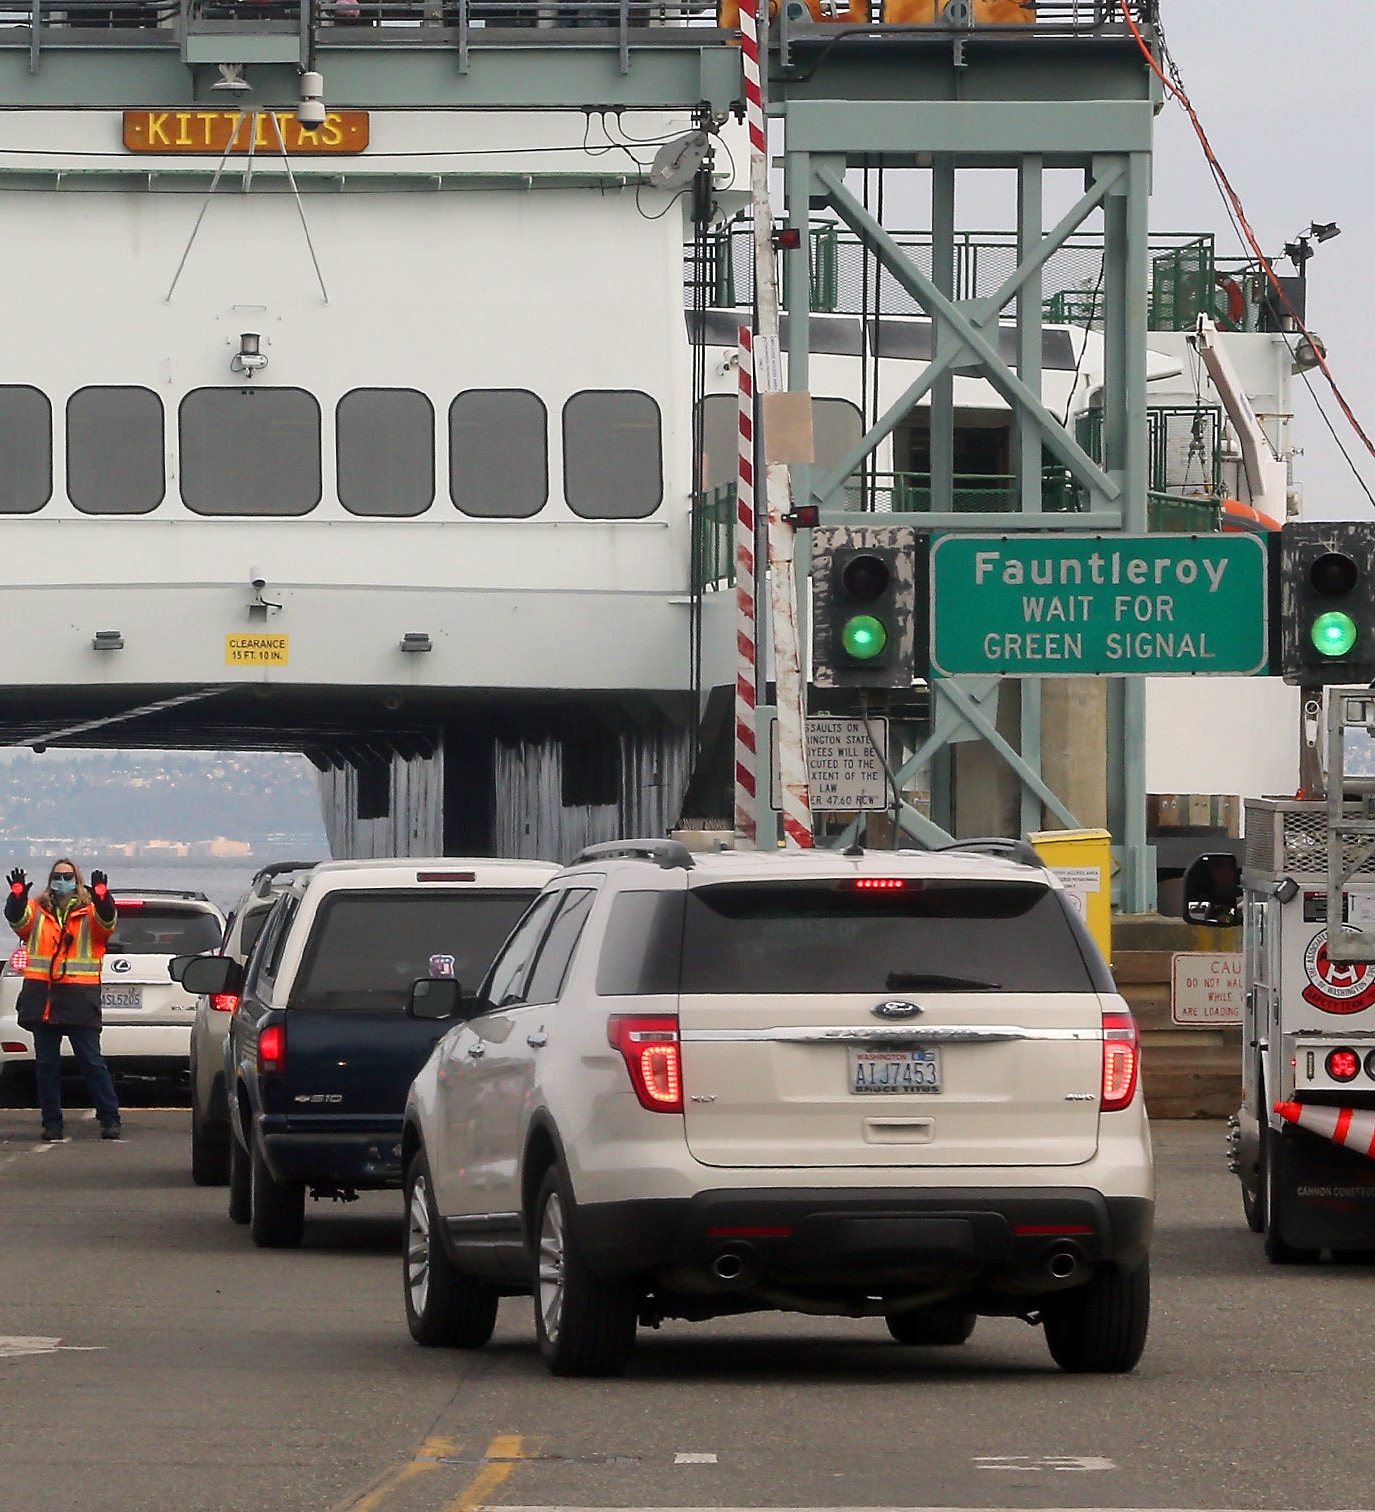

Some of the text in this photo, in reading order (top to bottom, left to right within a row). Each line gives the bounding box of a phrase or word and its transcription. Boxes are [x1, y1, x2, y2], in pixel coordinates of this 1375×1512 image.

[148, 112, 343, 145] KITTITAS
[975, 551, 1229, 593] Fauntleroy
[1022, 595, 1174, 622] WAIT FOR
[229, 640, 285, 648] CLEARANCE
[983, 632, 1217, 660] GREEN SIGNAL
[233, 651, 242, 660] 15
[259, 651, 269, 660] 10
[805, 724, 859, 733] SSAULTS ON
[846, 736, 871, 745] STATE
[838, 748, 858, 757] WILL
[864, 748, 875, 757] BE
[844, 760, 854, 769] TO
[858, 760, 874, 769] THE
[811, 772, 878, 781] XTENT OF THE
[819, 784, 838, 793] LAW
[827, 796, 852, 805] 47.60
[1186, 978, 1243, 988] DO NOT WAL
[1208, 992, 1232, 1002] WHILE
[1182, 1007, 1239, 1017] ARE LOADING
[856, 1063, 937, 1085] AIJ7453
[855, 1085, 939, 1093] BRUCE TITUS
[1297, 1186, 1331, 1197] CANNON
